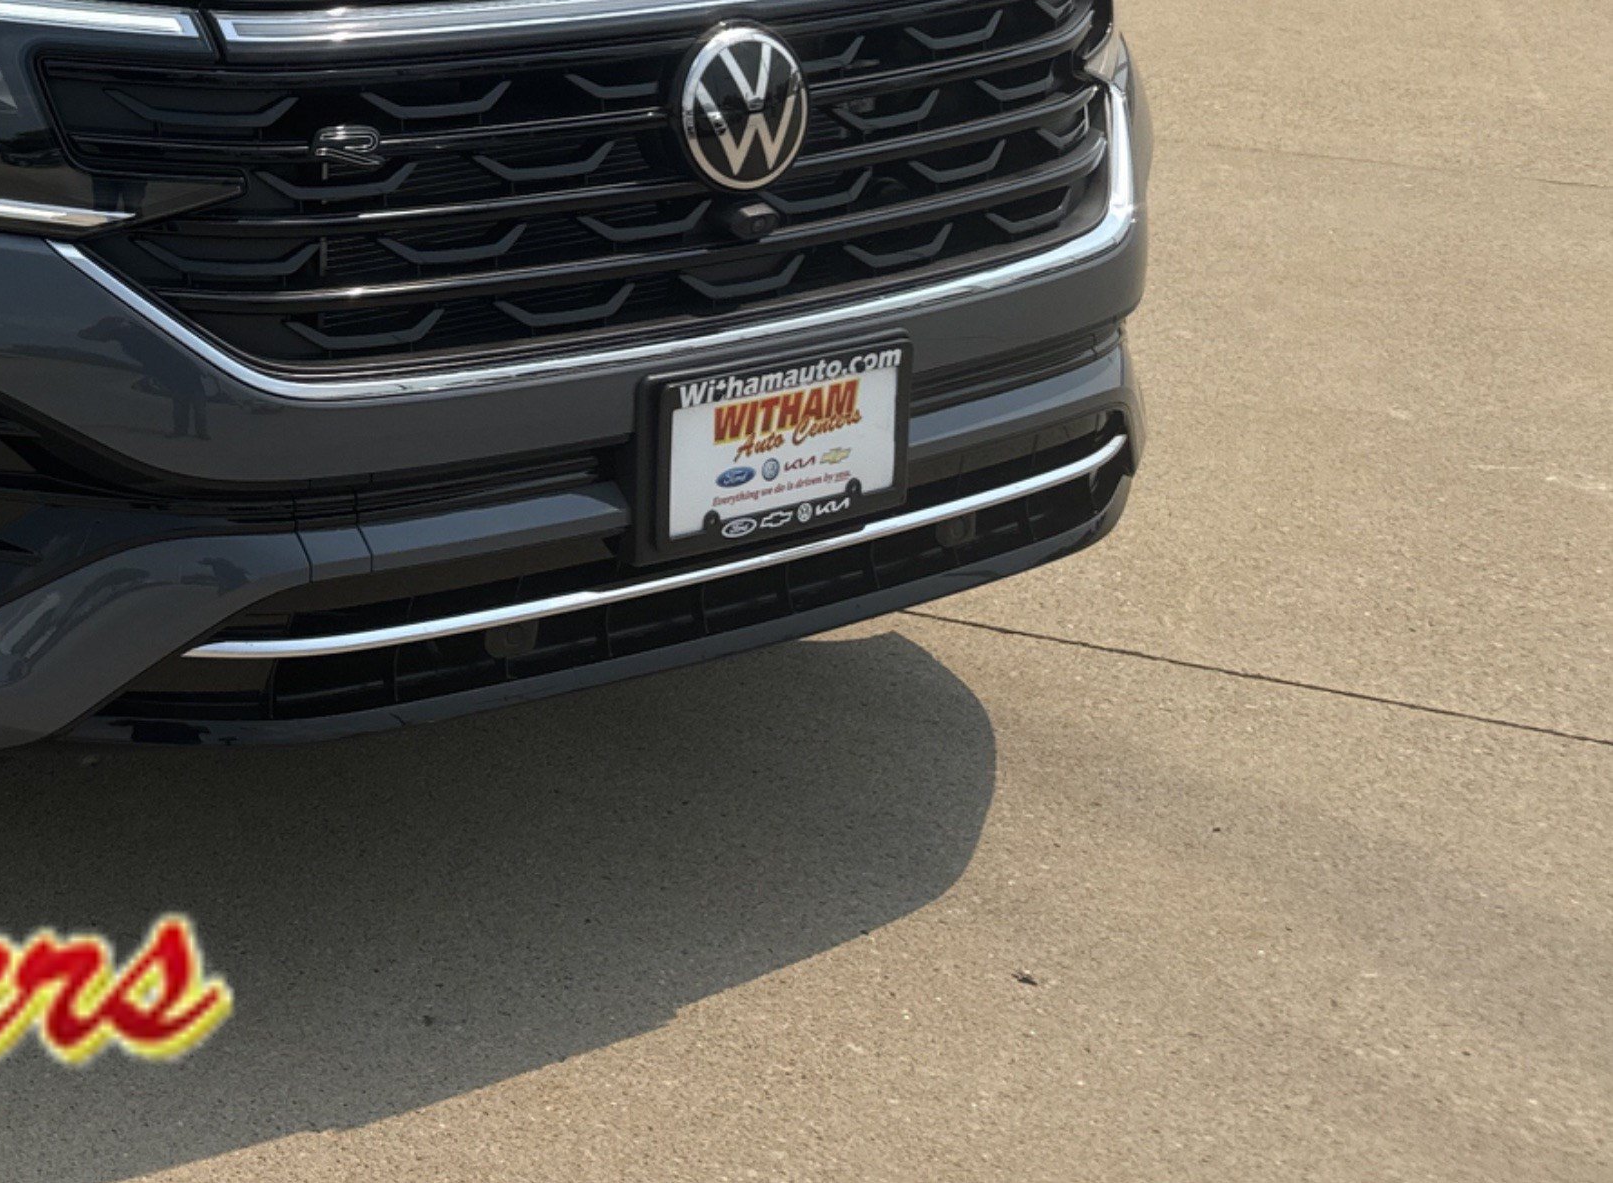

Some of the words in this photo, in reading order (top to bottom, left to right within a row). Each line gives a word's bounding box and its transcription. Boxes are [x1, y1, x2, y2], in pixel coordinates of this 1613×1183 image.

[714, 378, 859, 444] WITHAM
[733, 431, 784, 462] Auto
[792, 409, 862, 446] Centers
[712, 489, 760, 507] Everything
[761, 486, 773, 496] we
[774, 483, 785, 493] do
[794, 475, 822, 489] driven
[823, 471, 833, 484] by
